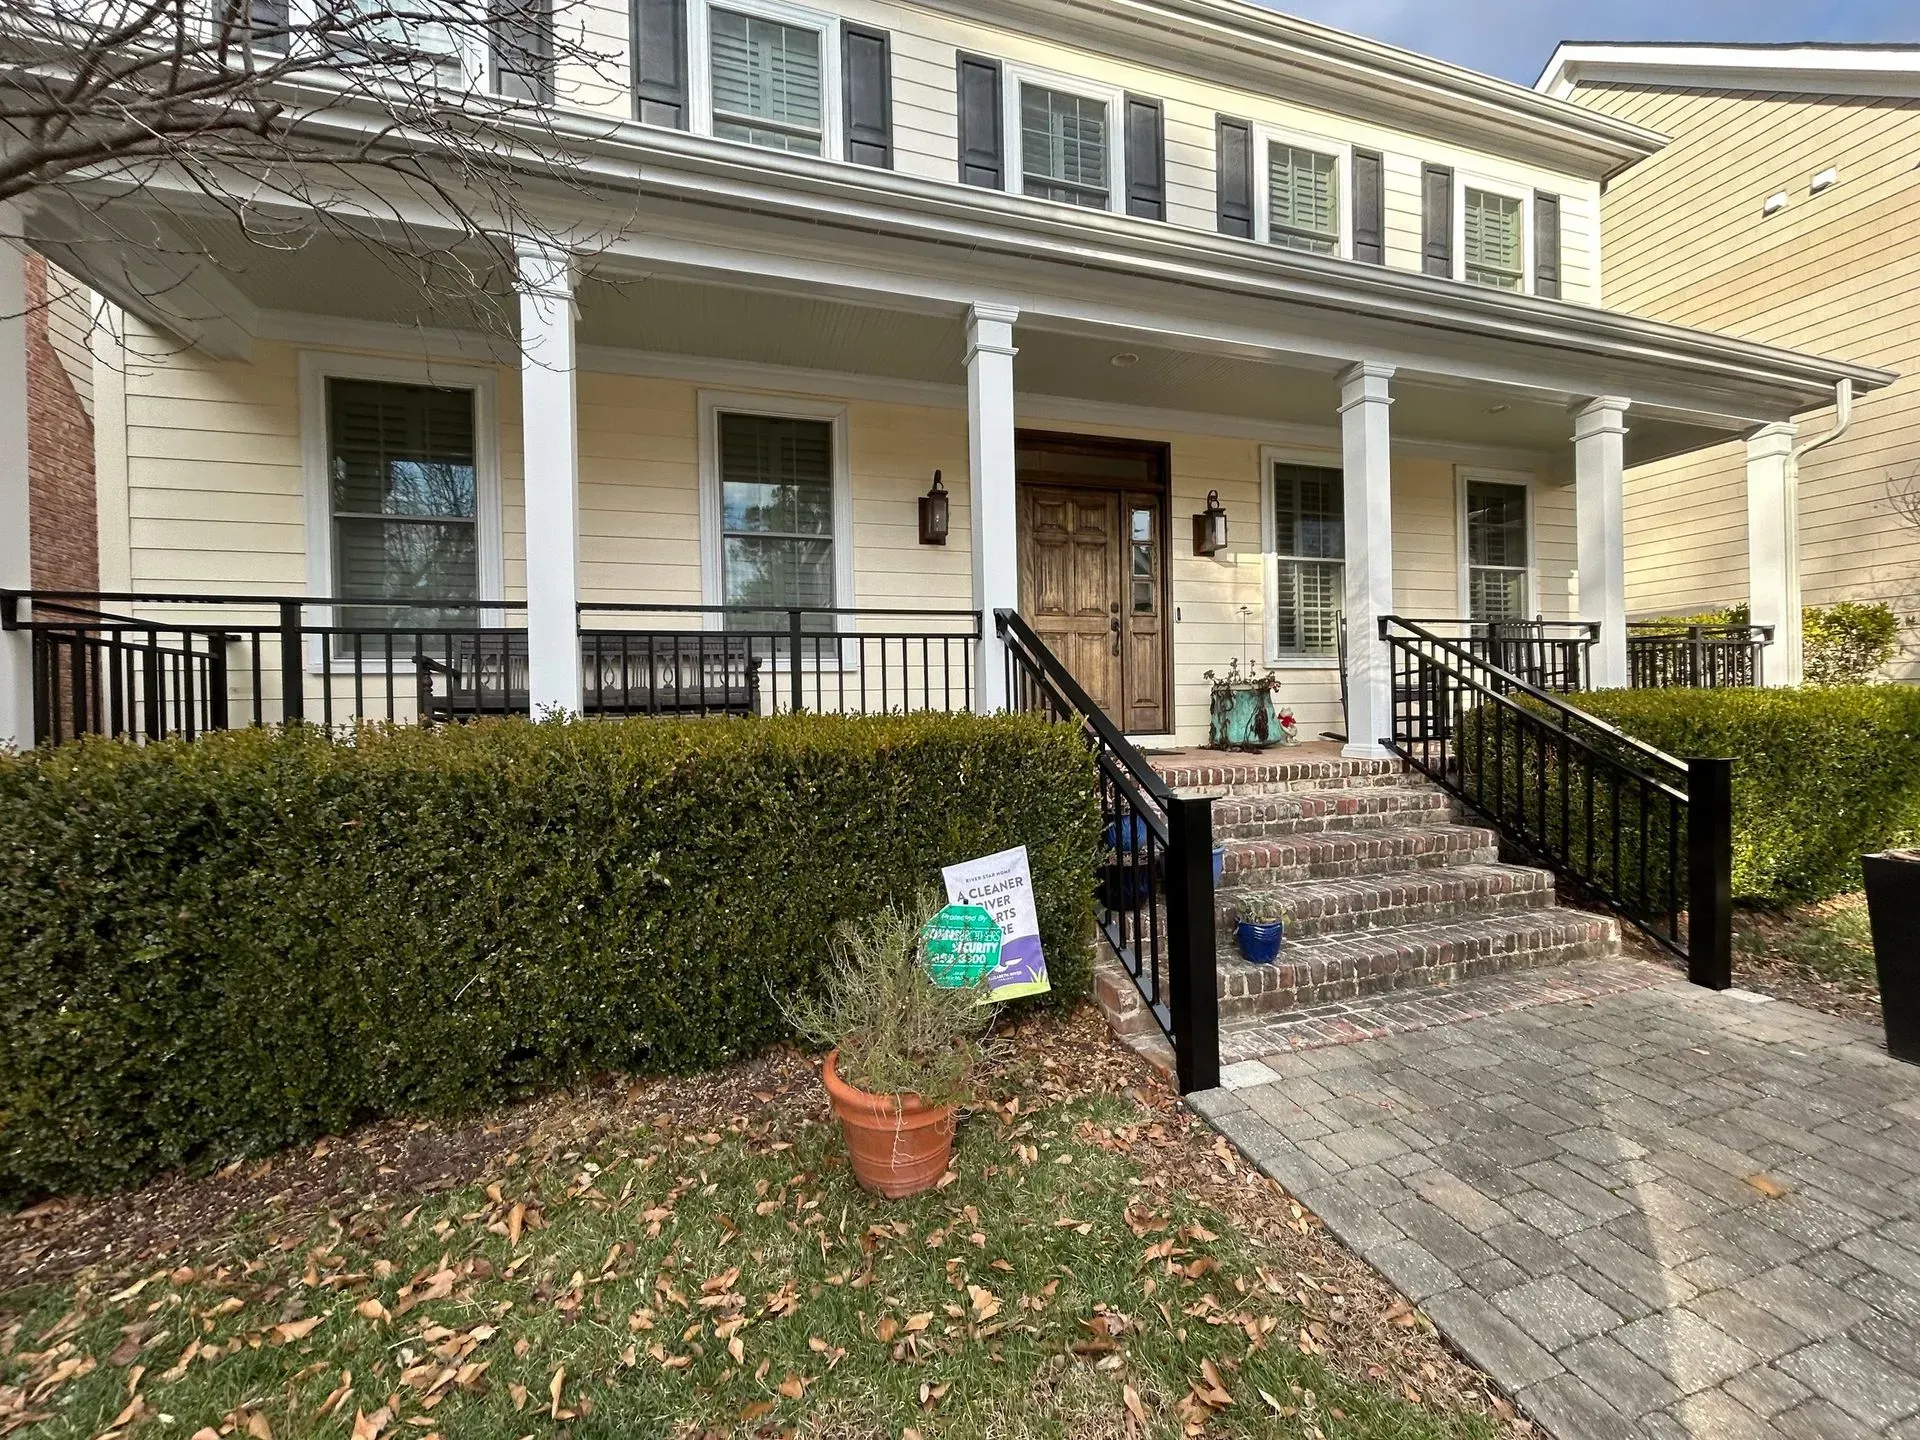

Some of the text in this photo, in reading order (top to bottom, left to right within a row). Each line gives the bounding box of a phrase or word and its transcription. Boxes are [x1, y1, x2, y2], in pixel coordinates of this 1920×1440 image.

[957, 876, 1024, 903] A CLEANER
[976, 895, 1011, 911] IVER
[977, 914, 988, 923] By
[993, 908, 1017, 923] RTS
